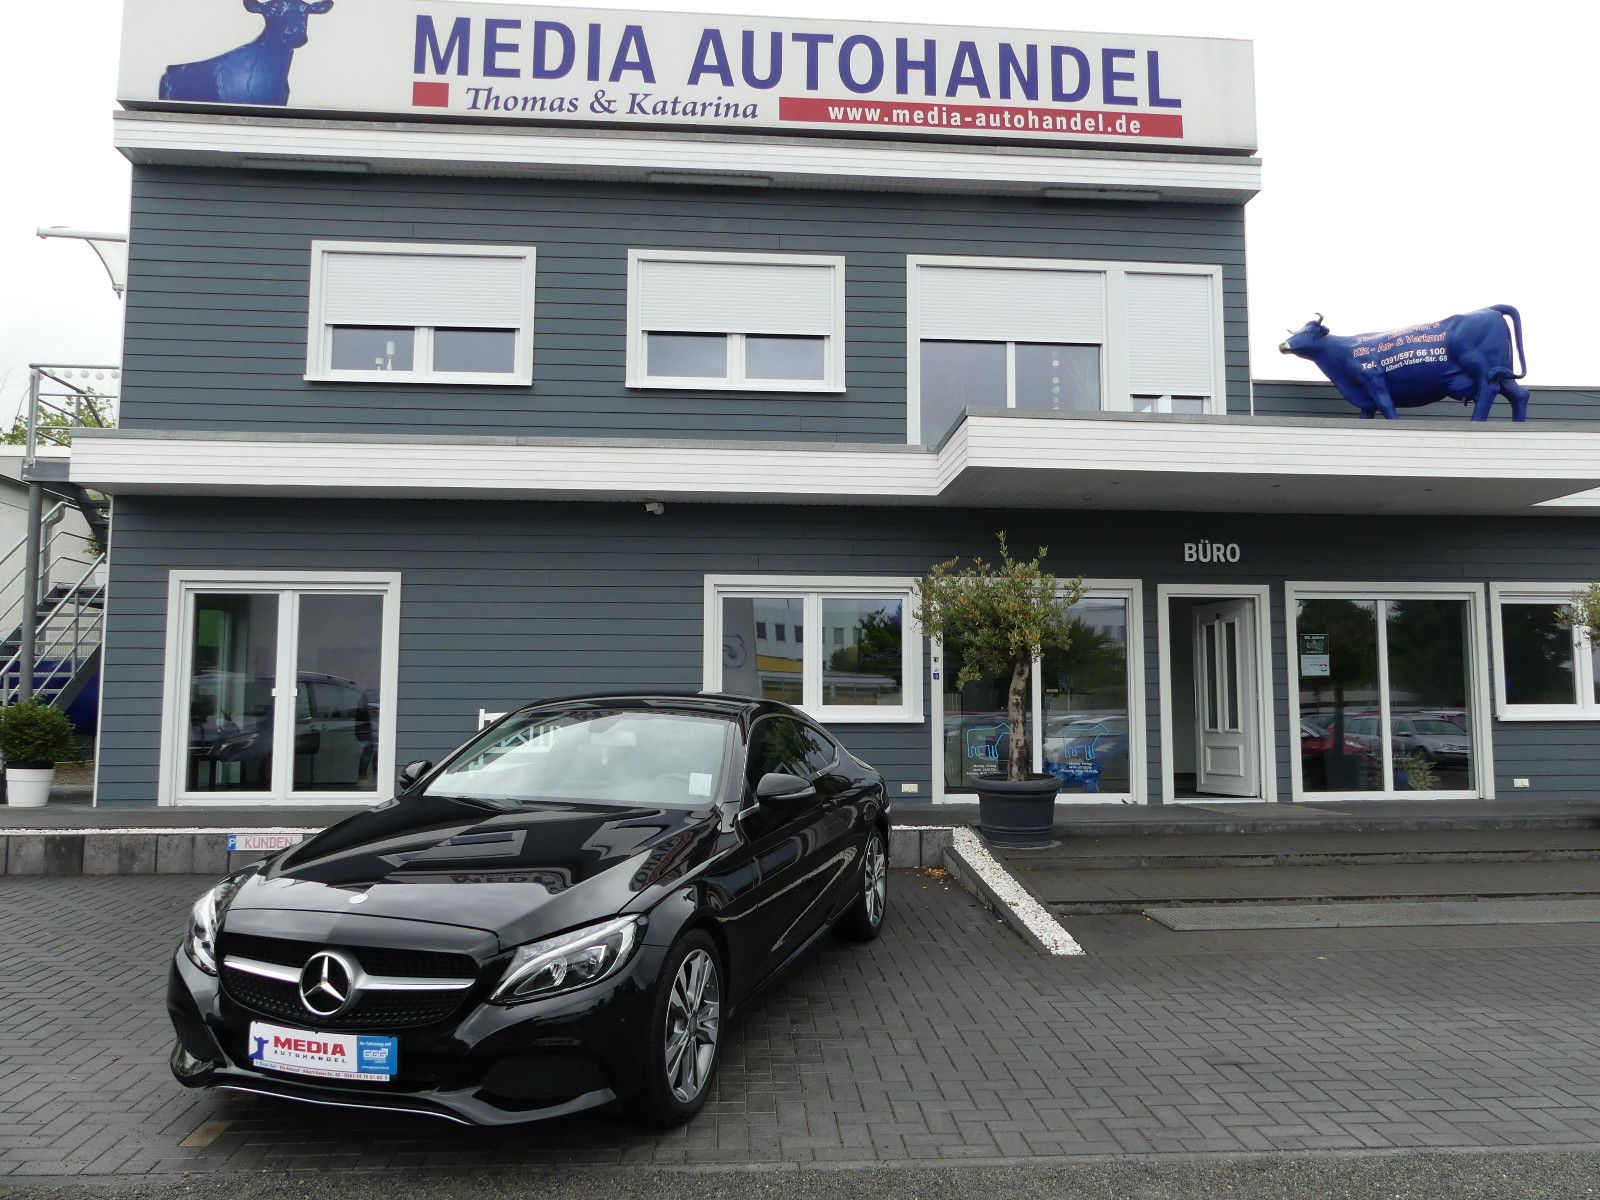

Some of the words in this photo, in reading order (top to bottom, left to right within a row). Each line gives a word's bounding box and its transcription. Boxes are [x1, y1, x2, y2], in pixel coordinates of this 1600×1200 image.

[413, 14, 657, 84] MEDIA
[687, 28, 1182, 109] AUTOHANDEL
[465, 86, 580, 114] Thomas
[589, 89, 618, 115] &
[626, 92, 759, 119] Katarina
[828, 104, 1142, 134] www.media-autohandel.de
[1406, 331, 1446, 344] Verkauf
[1361, 361, 1377, 371] Tel.
[1380, 350, 1414, 367] 0391/597
[1416, 348, 1427, 357] 66
[1429, 347, 1446, 356] 100
[1184, 539, 1241, 563] BÜRO
[228, 837, 236, 847] P
[244, 837, 293, 849] KUNDEN
[274, 1036, 345, 1056] MEDIA
[274, 1050, 346, 1063] AUTOHANDEL
